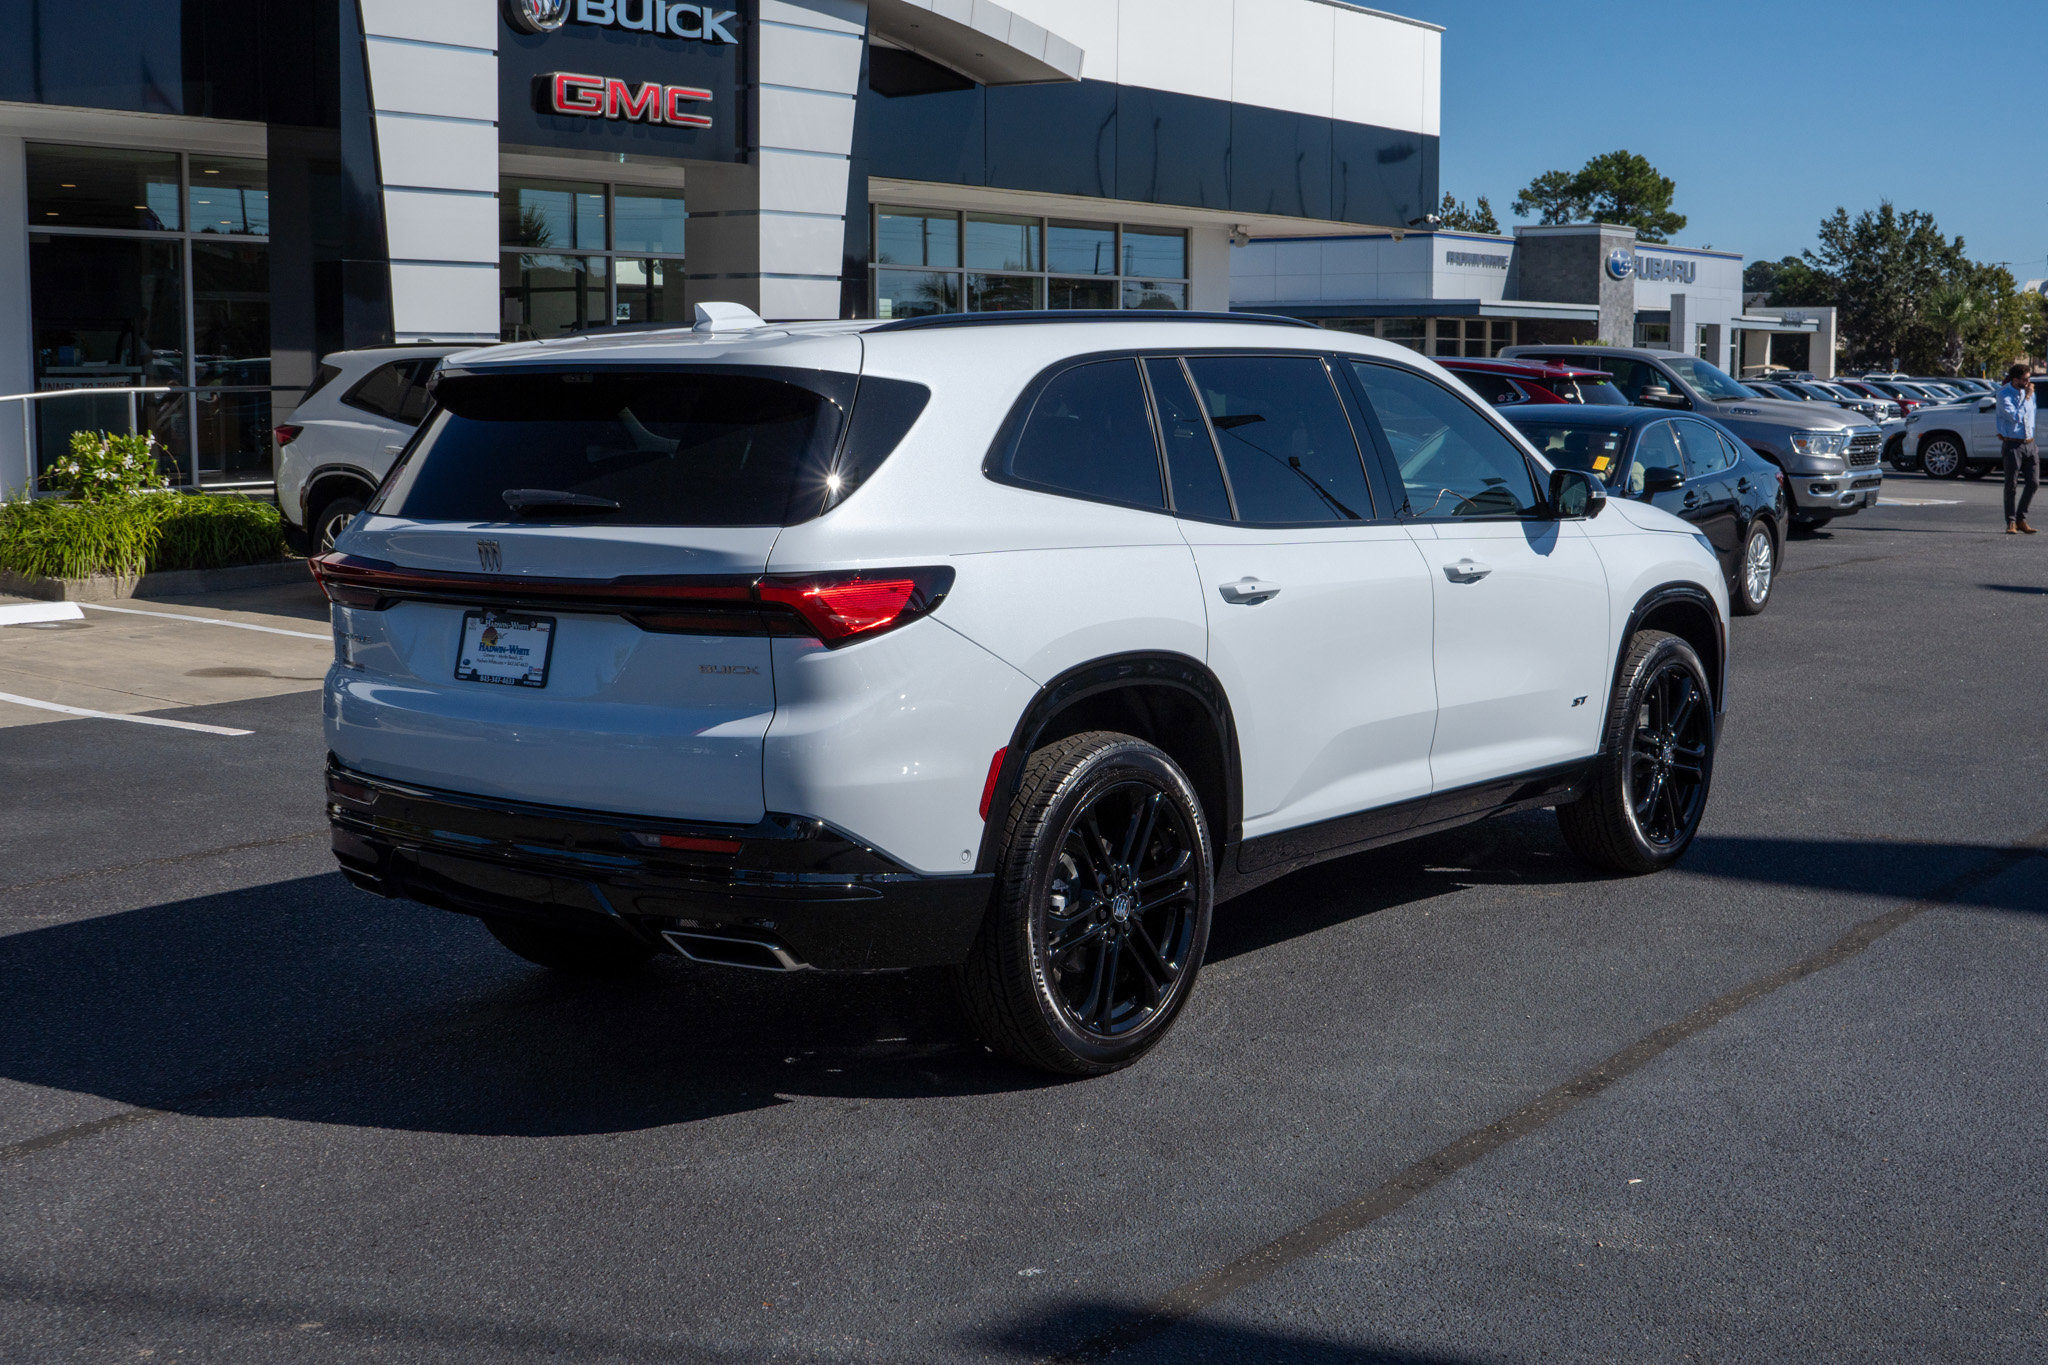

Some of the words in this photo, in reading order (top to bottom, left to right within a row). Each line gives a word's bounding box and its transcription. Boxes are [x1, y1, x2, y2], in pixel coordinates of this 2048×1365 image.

[577, 0, 739, 44] BUICK
[553, 71, 713, 129] GMC
[698, 665, 760, 675] BUICK
[1571, 695, 1588, 707] ST
